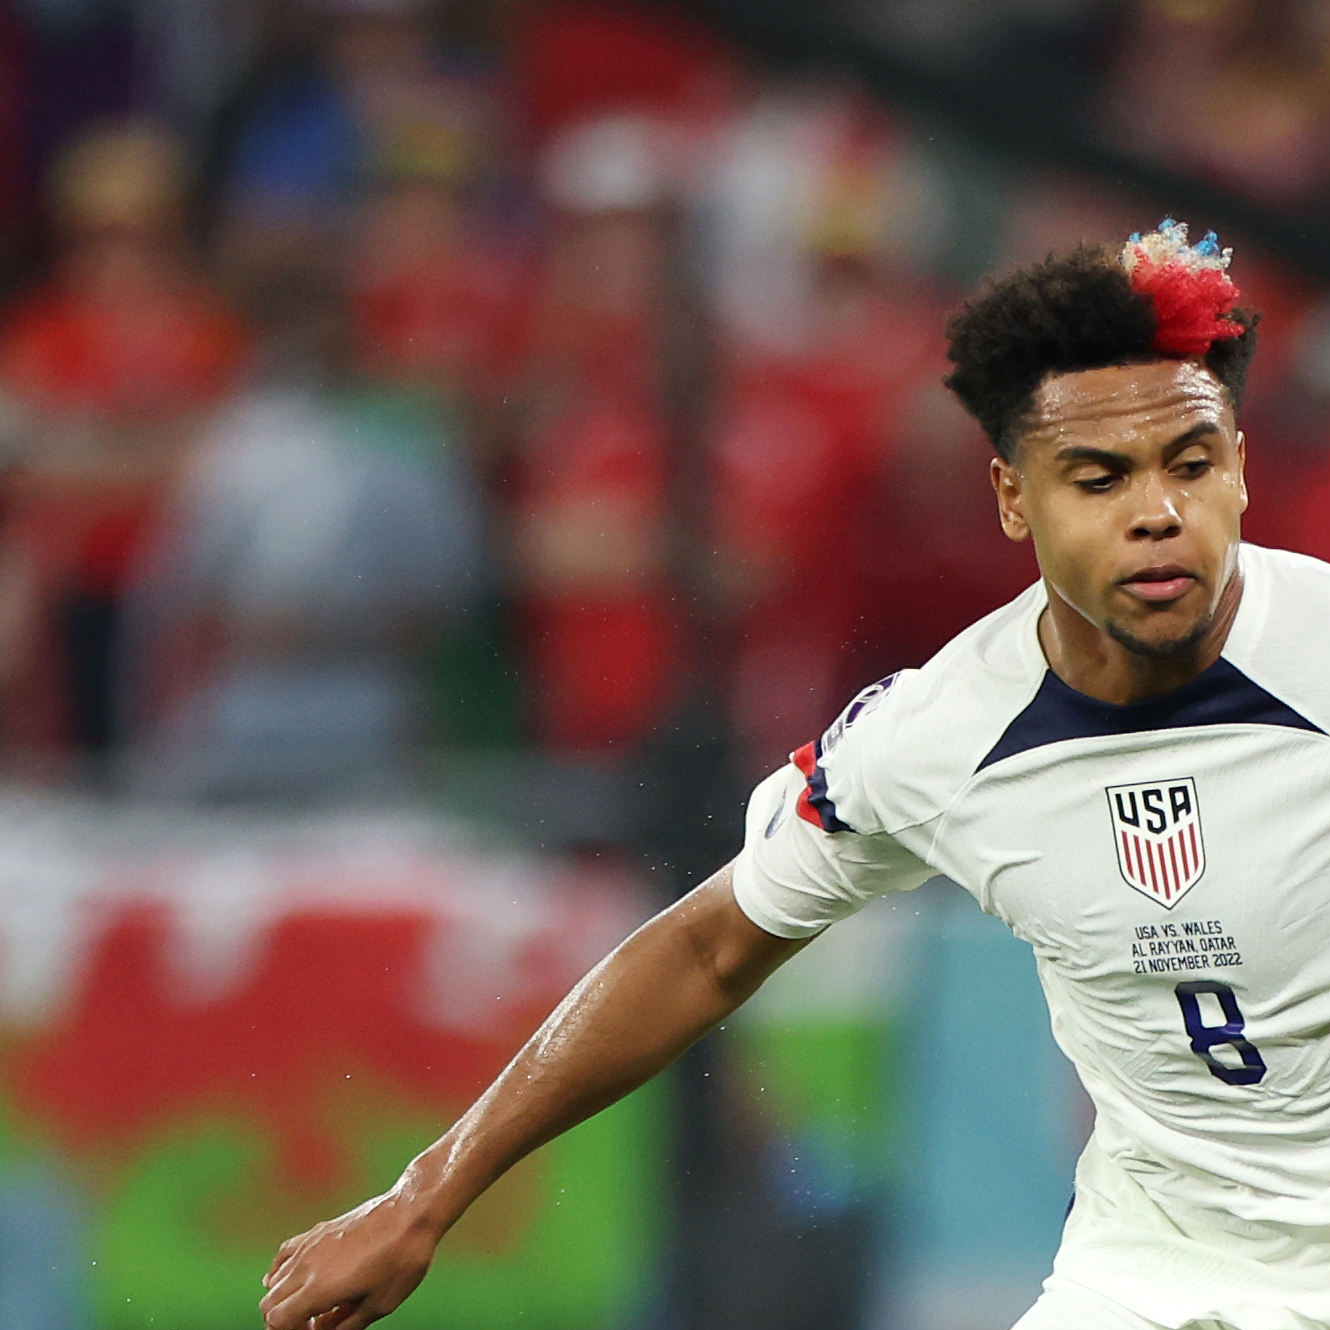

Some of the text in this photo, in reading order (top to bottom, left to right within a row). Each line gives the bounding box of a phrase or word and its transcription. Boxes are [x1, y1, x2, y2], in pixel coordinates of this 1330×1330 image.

[1115, 786, 1192, 834] USA
[1135, 920, 1223, 940] USA VS. WALES
[1132, 936, 1237, 957] AL RAYYAN, QATAR
[1133, 952, 1243, 974] 21 NOVEMBER 2022
[1174, 980, 1267, 1086] 8
